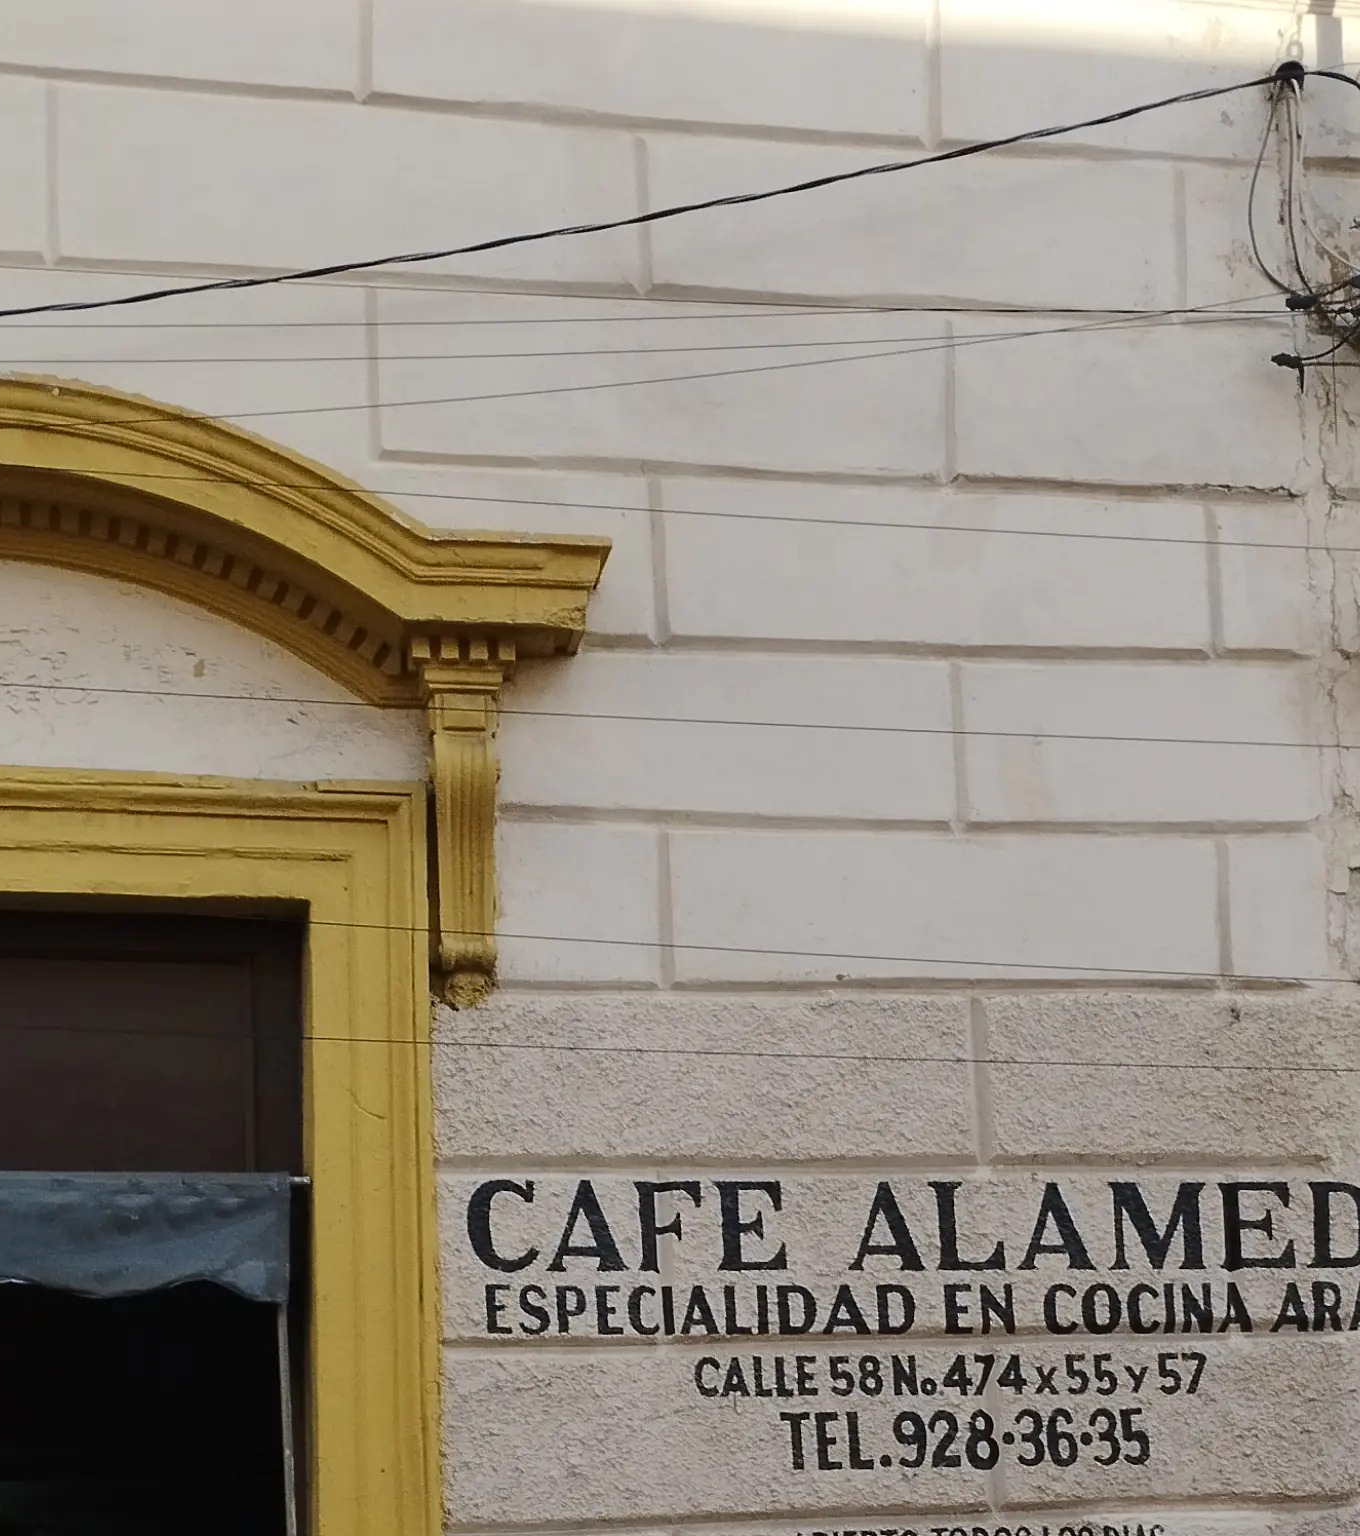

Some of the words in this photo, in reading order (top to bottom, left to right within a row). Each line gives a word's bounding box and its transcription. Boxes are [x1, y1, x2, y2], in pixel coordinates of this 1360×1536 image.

[466, 1178, 789, 1274] CAFE
[484, 1282, 918, 1337] ESPECIALIDAD
[943, 1282, 1017, 1336] EN
[1042, 1281, 1253, 1336] COCINA
[693, 1355, 820, 1398] CALLE
[828, 1354, 884, 1398] 58
